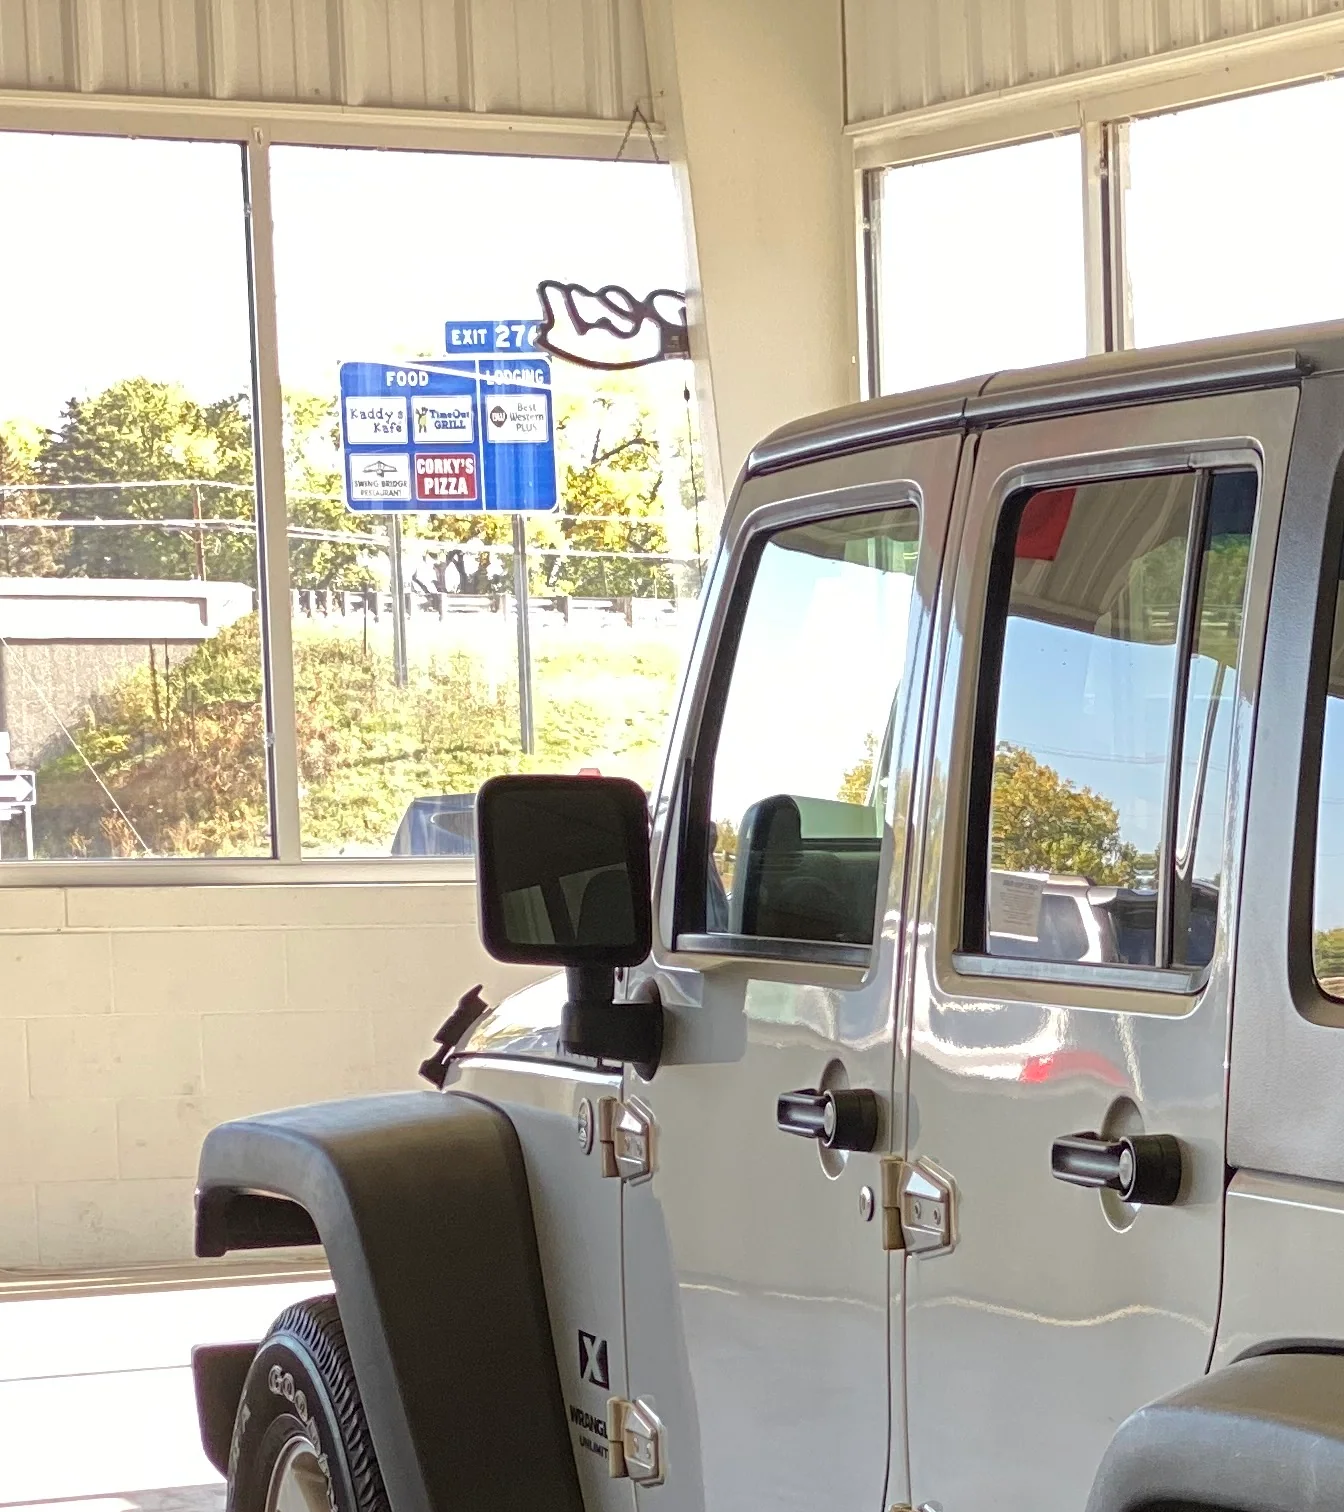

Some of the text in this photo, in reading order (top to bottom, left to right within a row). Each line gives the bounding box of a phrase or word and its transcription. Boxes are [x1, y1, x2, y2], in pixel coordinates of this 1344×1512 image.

[451, 328, 488, 346] EXIT
[386, 370, 429, 387] FOOD
[485, 368, 545, 386] LODGING
[350, 407, 404, 424] Kaddys
[434, 419, 466, 430] GRILL
[510, 412, 544, 421] Western
[416, 457, 474, 475] CORKY'S
[354, 480, 407, 488] SWING BRIDGE
[424, 476, 469, 495] PIZZA
[570, 1404, 608, 1440] WRANGL
[579, 1434, 609, 1459] UNLIMIT
